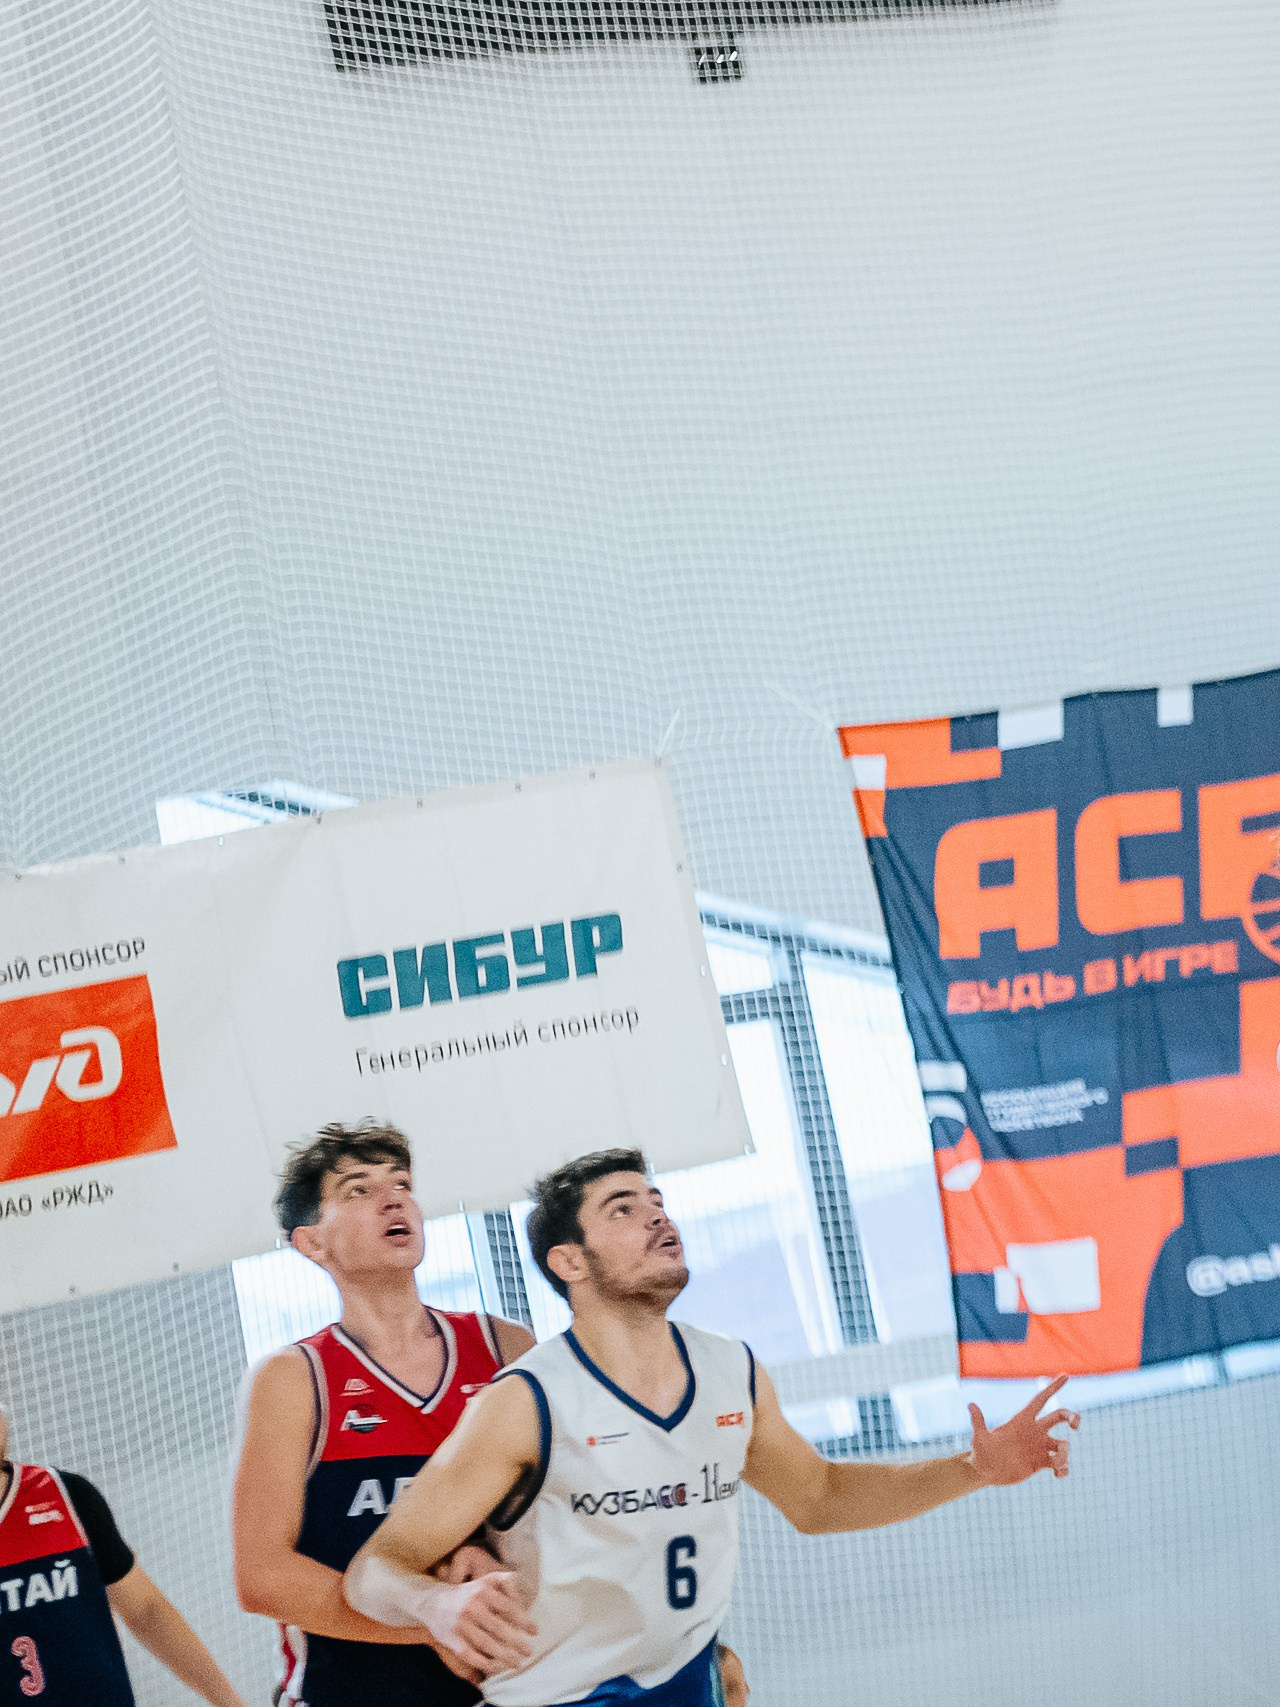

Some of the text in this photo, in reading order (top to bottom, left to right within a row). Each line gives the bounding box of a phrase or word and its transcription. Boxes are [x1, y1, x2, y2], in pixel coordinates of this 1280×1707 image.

[37, 935, 147, 978] СПОНСОР
[336, 911, 624, 1020] СИБУР
[946, 939, 1239, 1015] БУДЬ В ИГРЕ
[354, 1005, 640, 1078] Генеральный спонсор
[0, 1559, 79, 1614] ТАЙ
[667, 1534, 698, 1610] 6
[11, 1635, 46, 1696] 3
